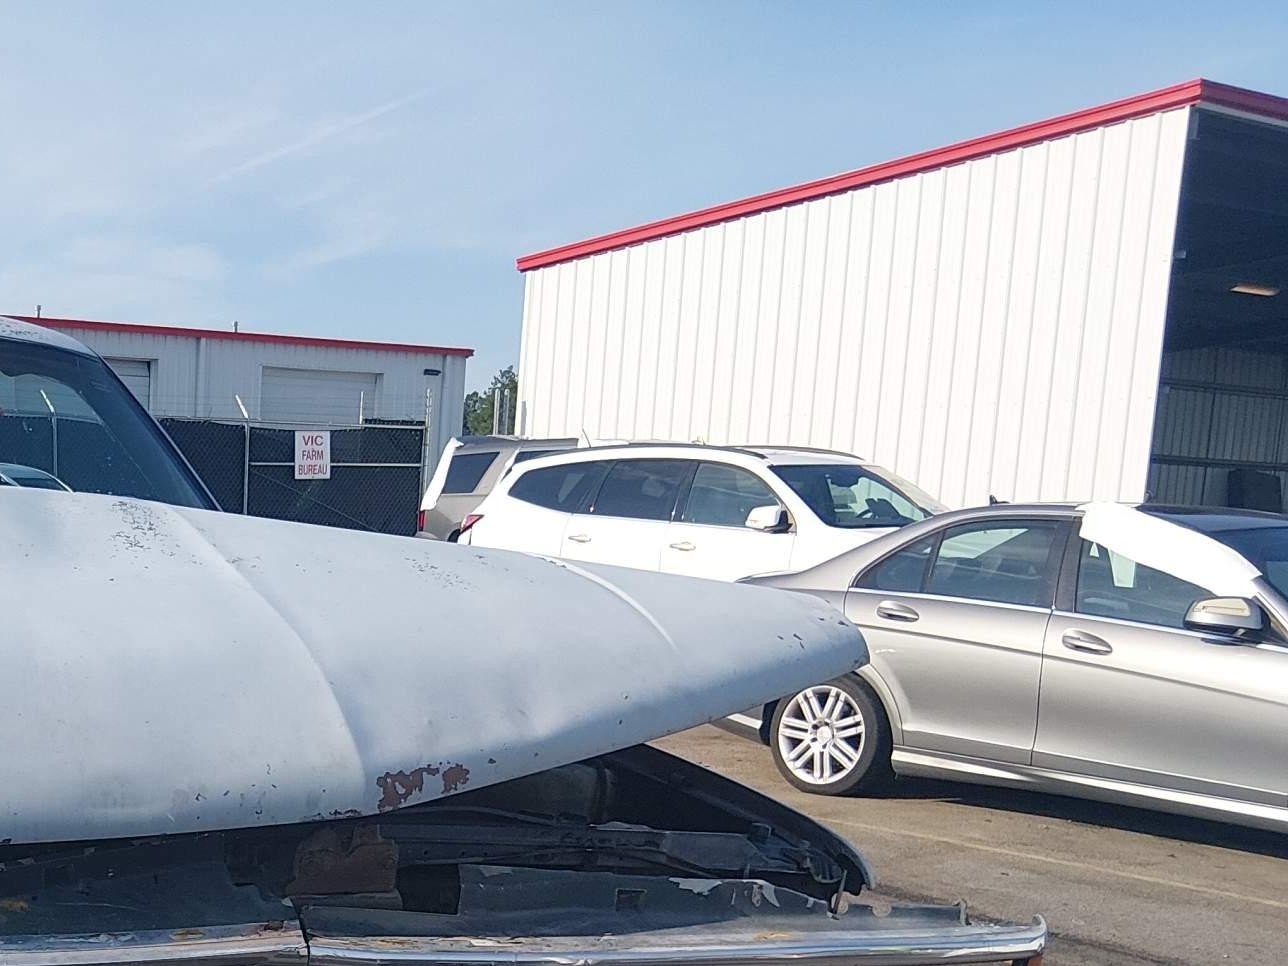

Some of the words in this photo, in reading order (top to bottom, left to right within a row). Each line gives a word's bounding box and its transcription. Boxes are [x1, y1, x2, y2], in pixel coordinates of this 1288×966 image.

[302, 435, 324, 447] VIC
[302, 450, 324, 461] FARM
[298, 464, 328, 476] BUREAU
